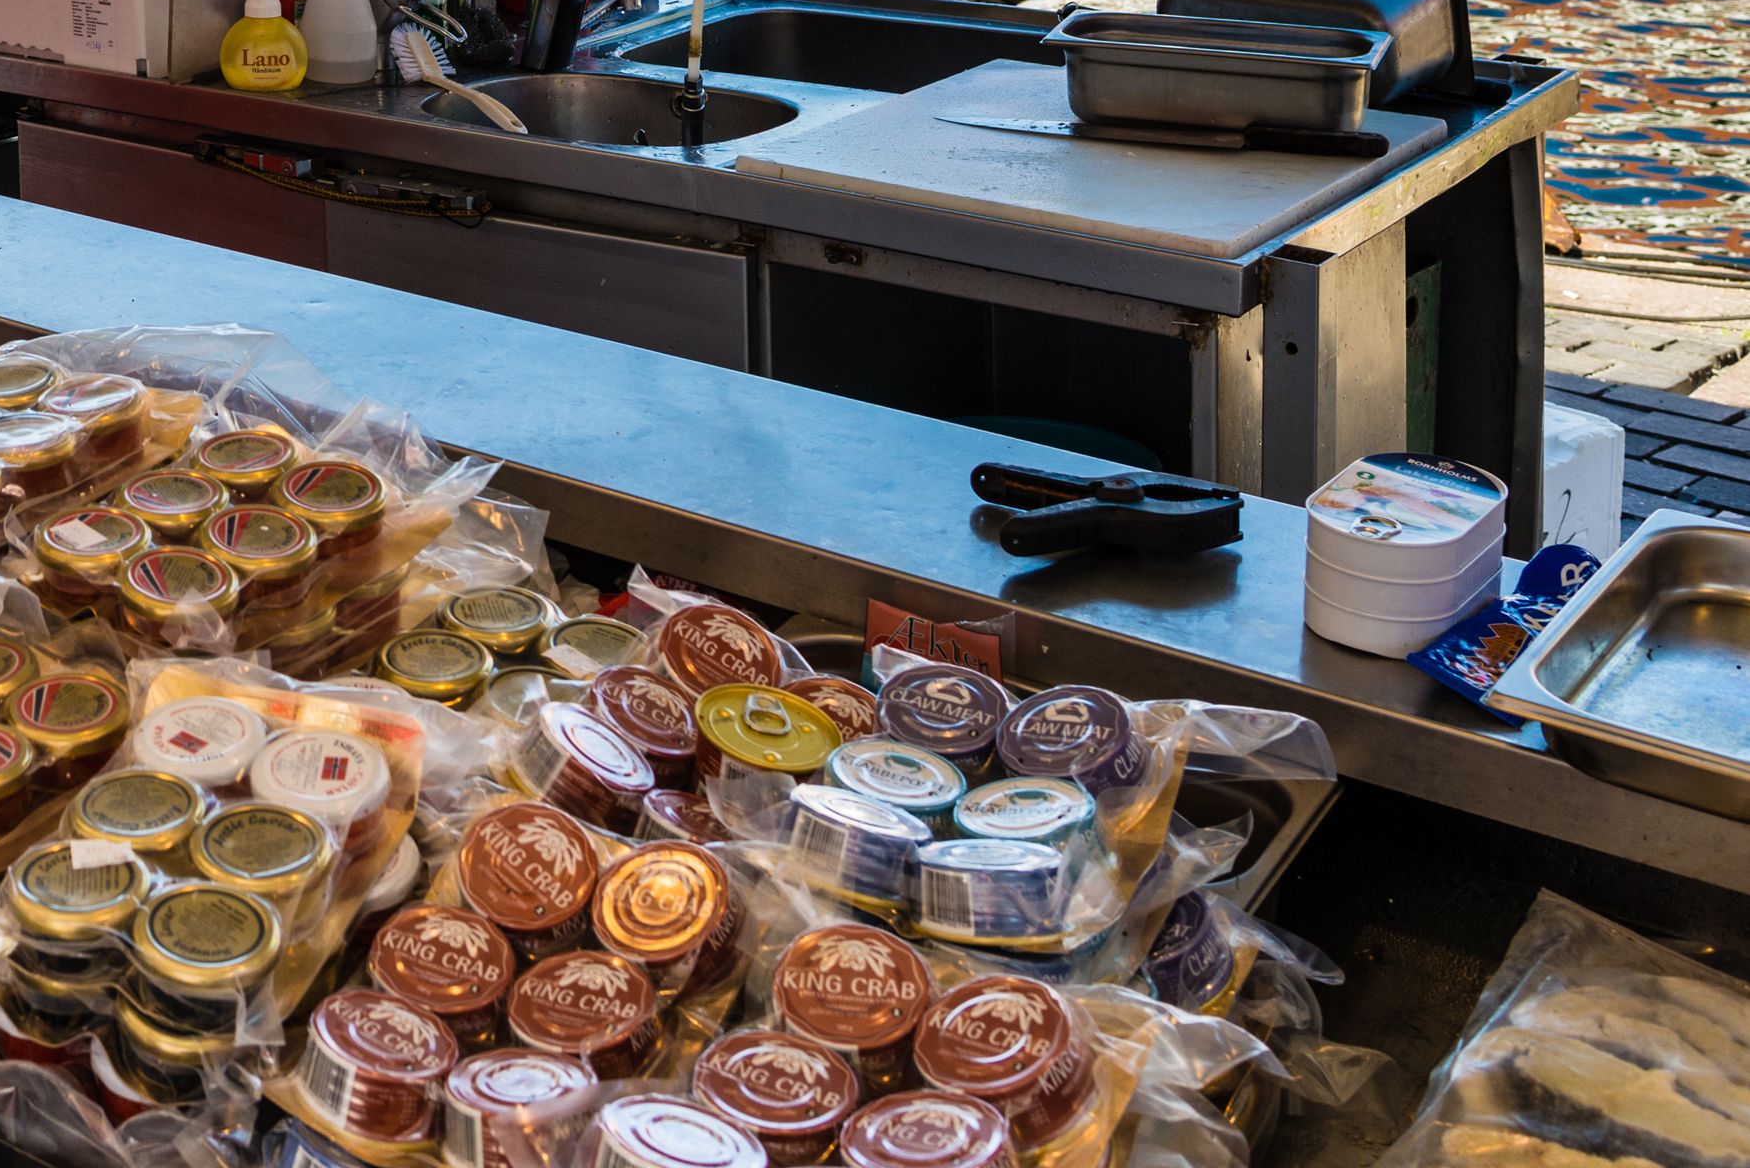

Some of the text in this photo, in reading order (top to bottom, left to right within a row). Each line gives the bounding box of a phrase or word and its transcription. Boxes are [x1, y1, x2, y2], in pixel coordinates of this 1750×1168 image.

[241, 48, 290, 67] Lano
[1395, 465, 1473, 493] Laksefilet
[1407, 458, 1478, 483] BORNHOLMS
[401, 637, 439, 653] Arctic
[672, 620, 769, 687] KING CRAB
[602, 679, 652, 713] KING
[889, 688, 995, 728] CLAW MEAT
[1009, 717, 1113, 742] CLAW MEAT
[248, 815, 301, 834] Caviar
[478, 820, 573, 911] KING CRAB
[657, 890, 716, 921] CRAB
[382, 932, 500, 983] KING CRAB
[519, 980, 638, 1019] KING CRAB
[783, 970, 916, 1001] KING CRAB
[328, 999, 440, 1070] KING CRAB
[929, 1011, 1050, 1058] KING CRAB
[708, 1052, 841, 1110] KING CRAB
